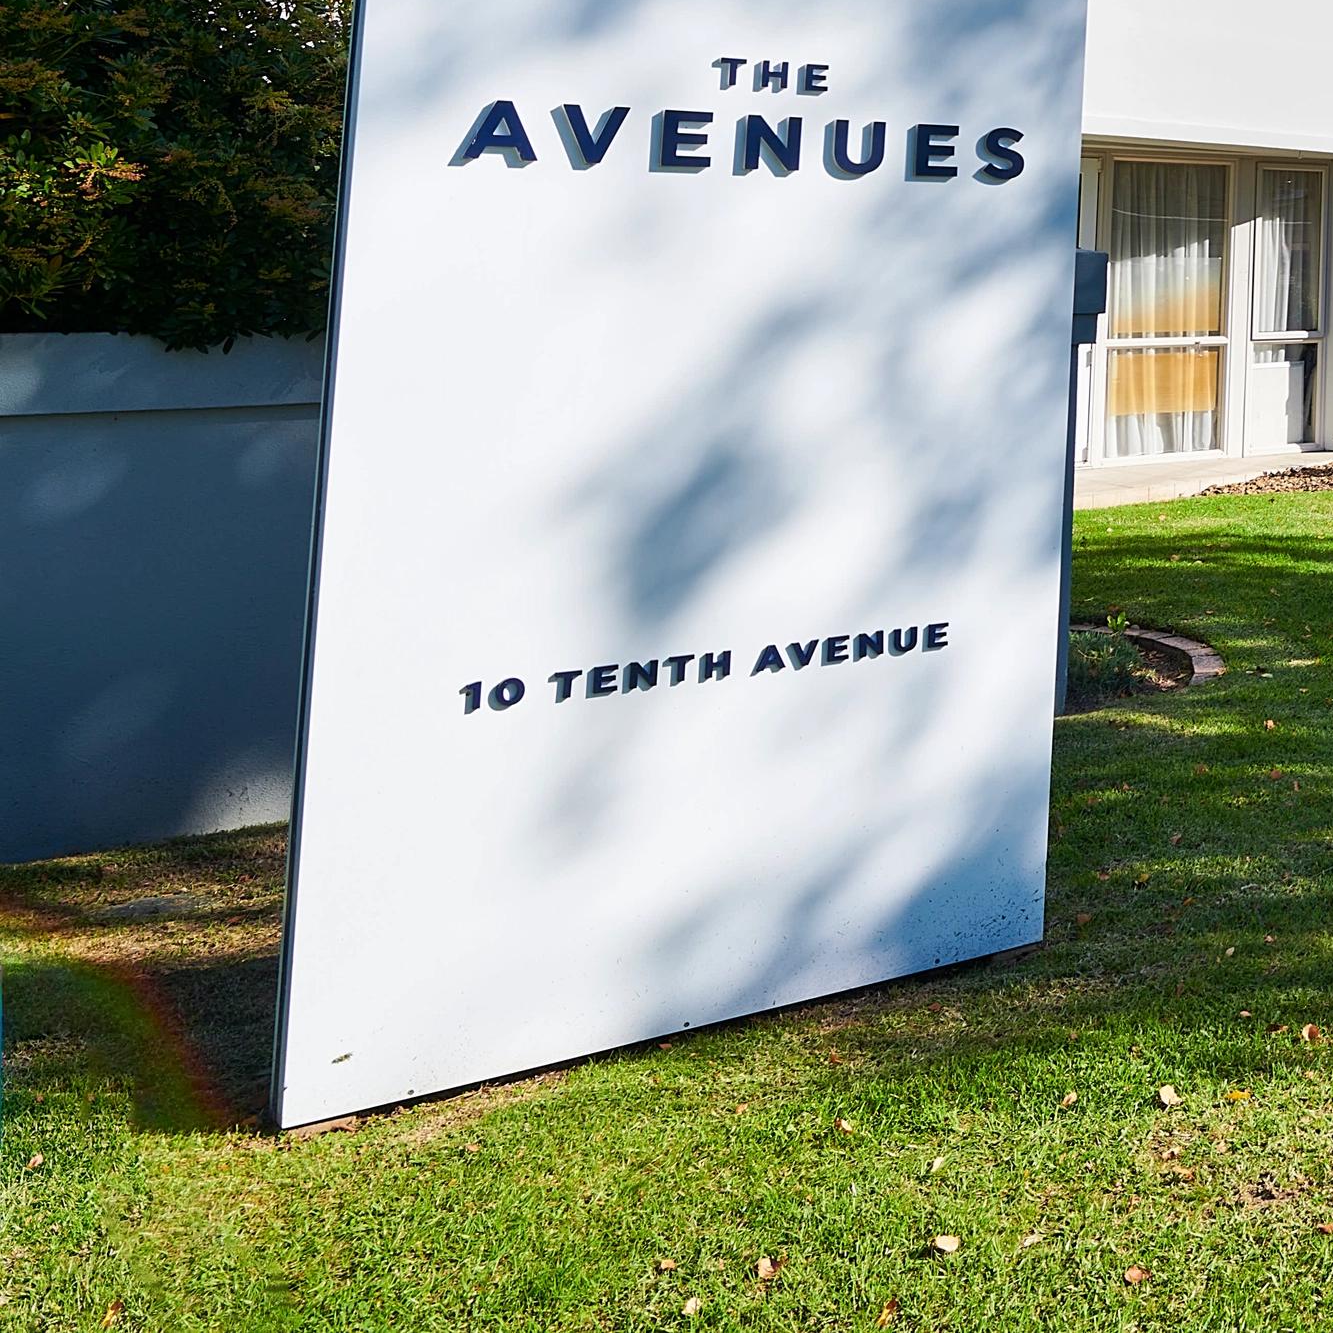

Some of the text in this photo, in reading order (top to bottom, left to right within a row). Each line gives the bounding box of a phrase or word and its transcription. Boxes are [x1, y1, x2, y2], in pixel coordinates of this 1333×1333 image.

[717, 57, 829, 93] THE
[455, 99, 1025, 183] AVENUES
[459, 622, 950, 714] 10 TENTH AVENUE
